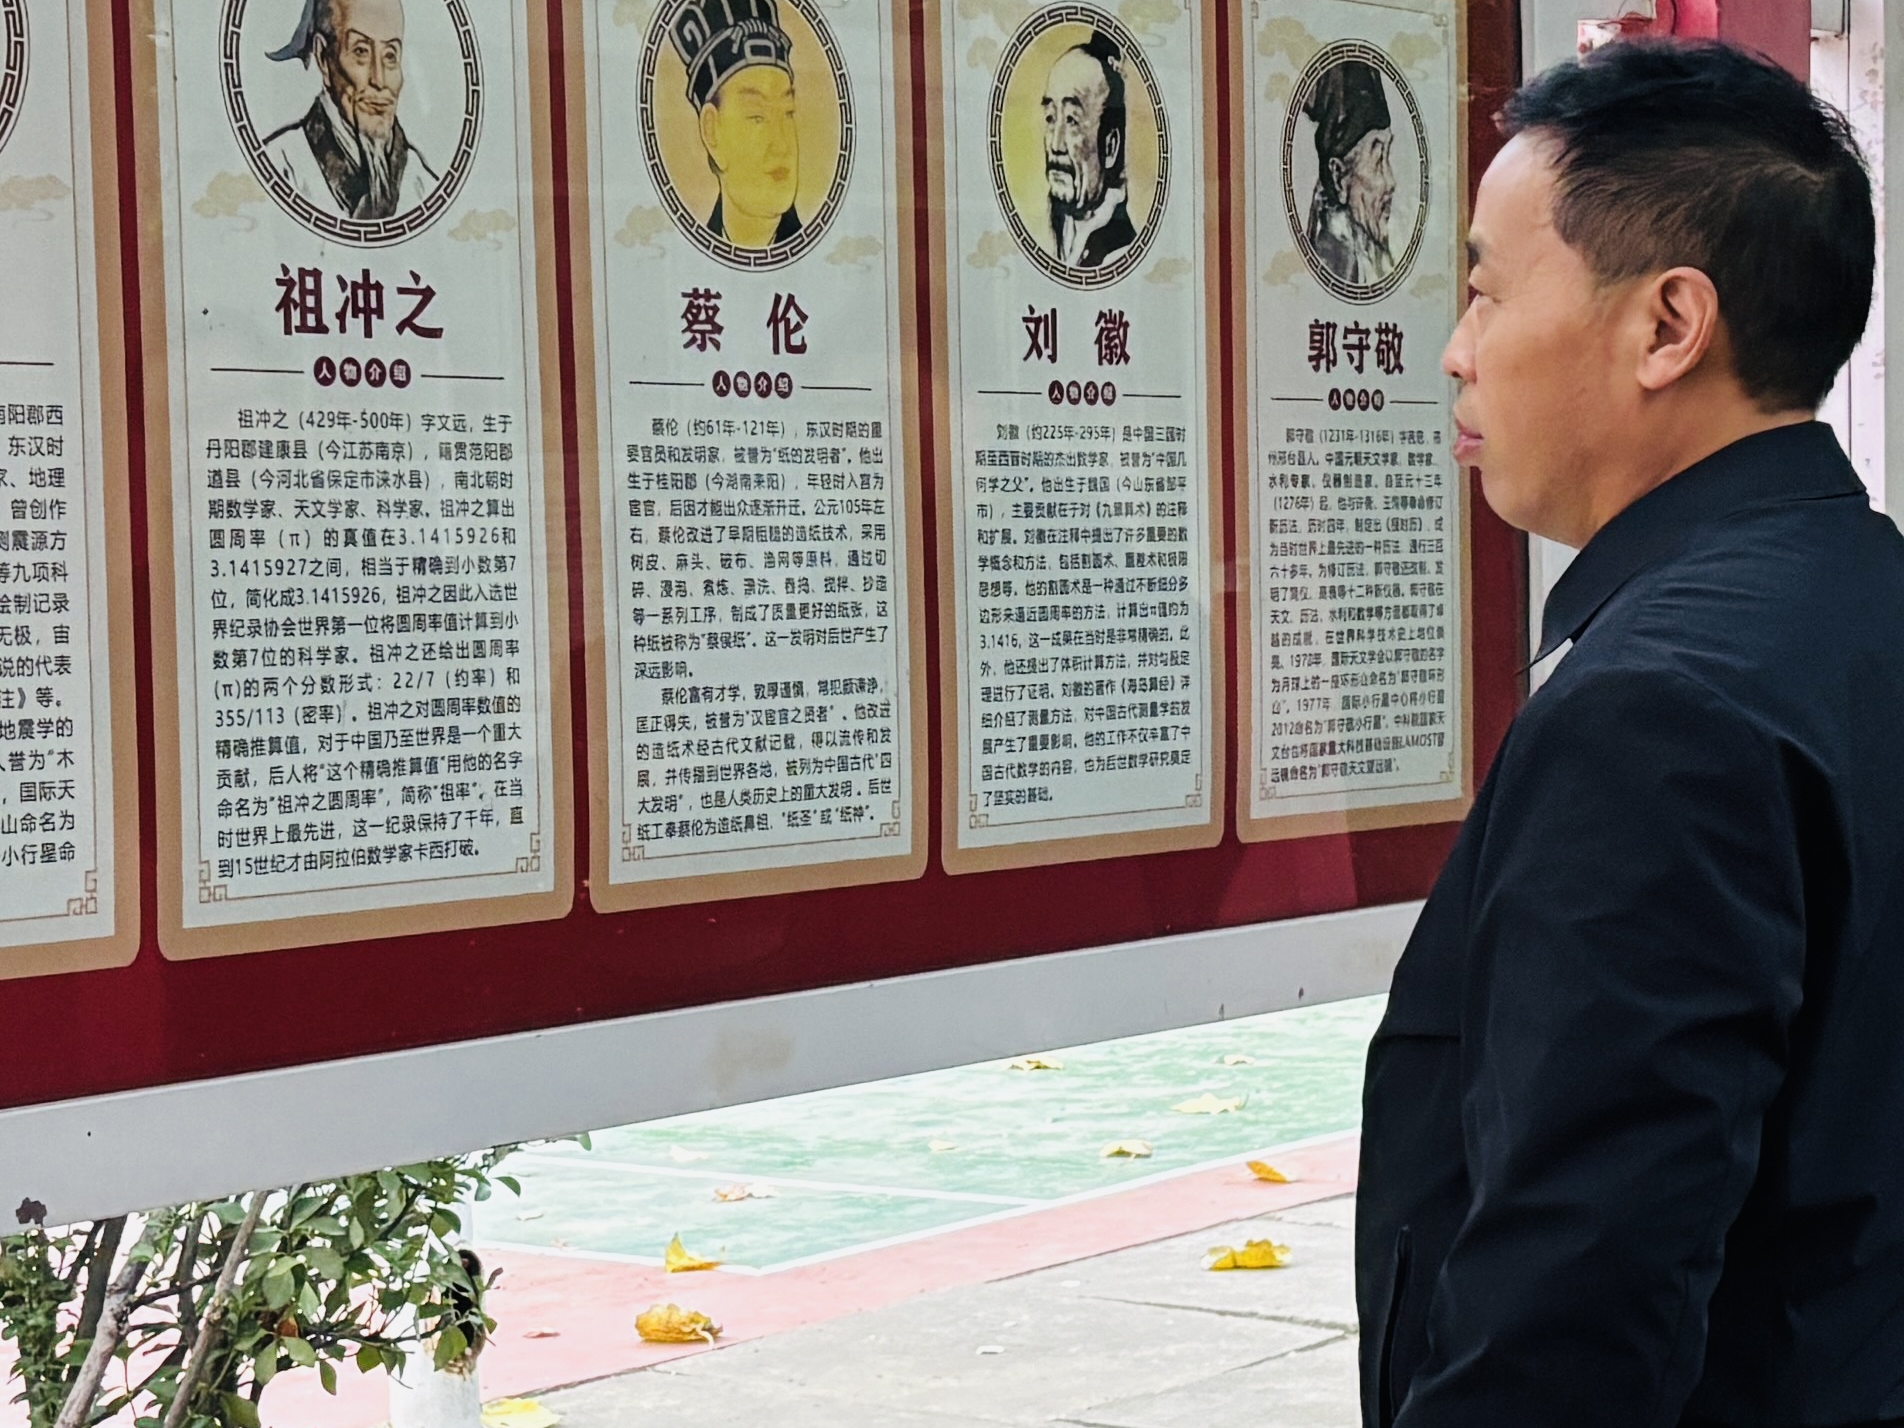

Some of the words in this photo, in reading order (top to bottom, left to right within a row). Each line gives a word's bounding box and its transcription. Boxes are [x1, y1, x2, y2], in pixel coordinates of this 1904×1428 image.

[274, 263, 444, 340] 祖冲之
[316, 360, 409, 384] 人物介绍
[1307, 318, 1405, 375] 郭守敬
